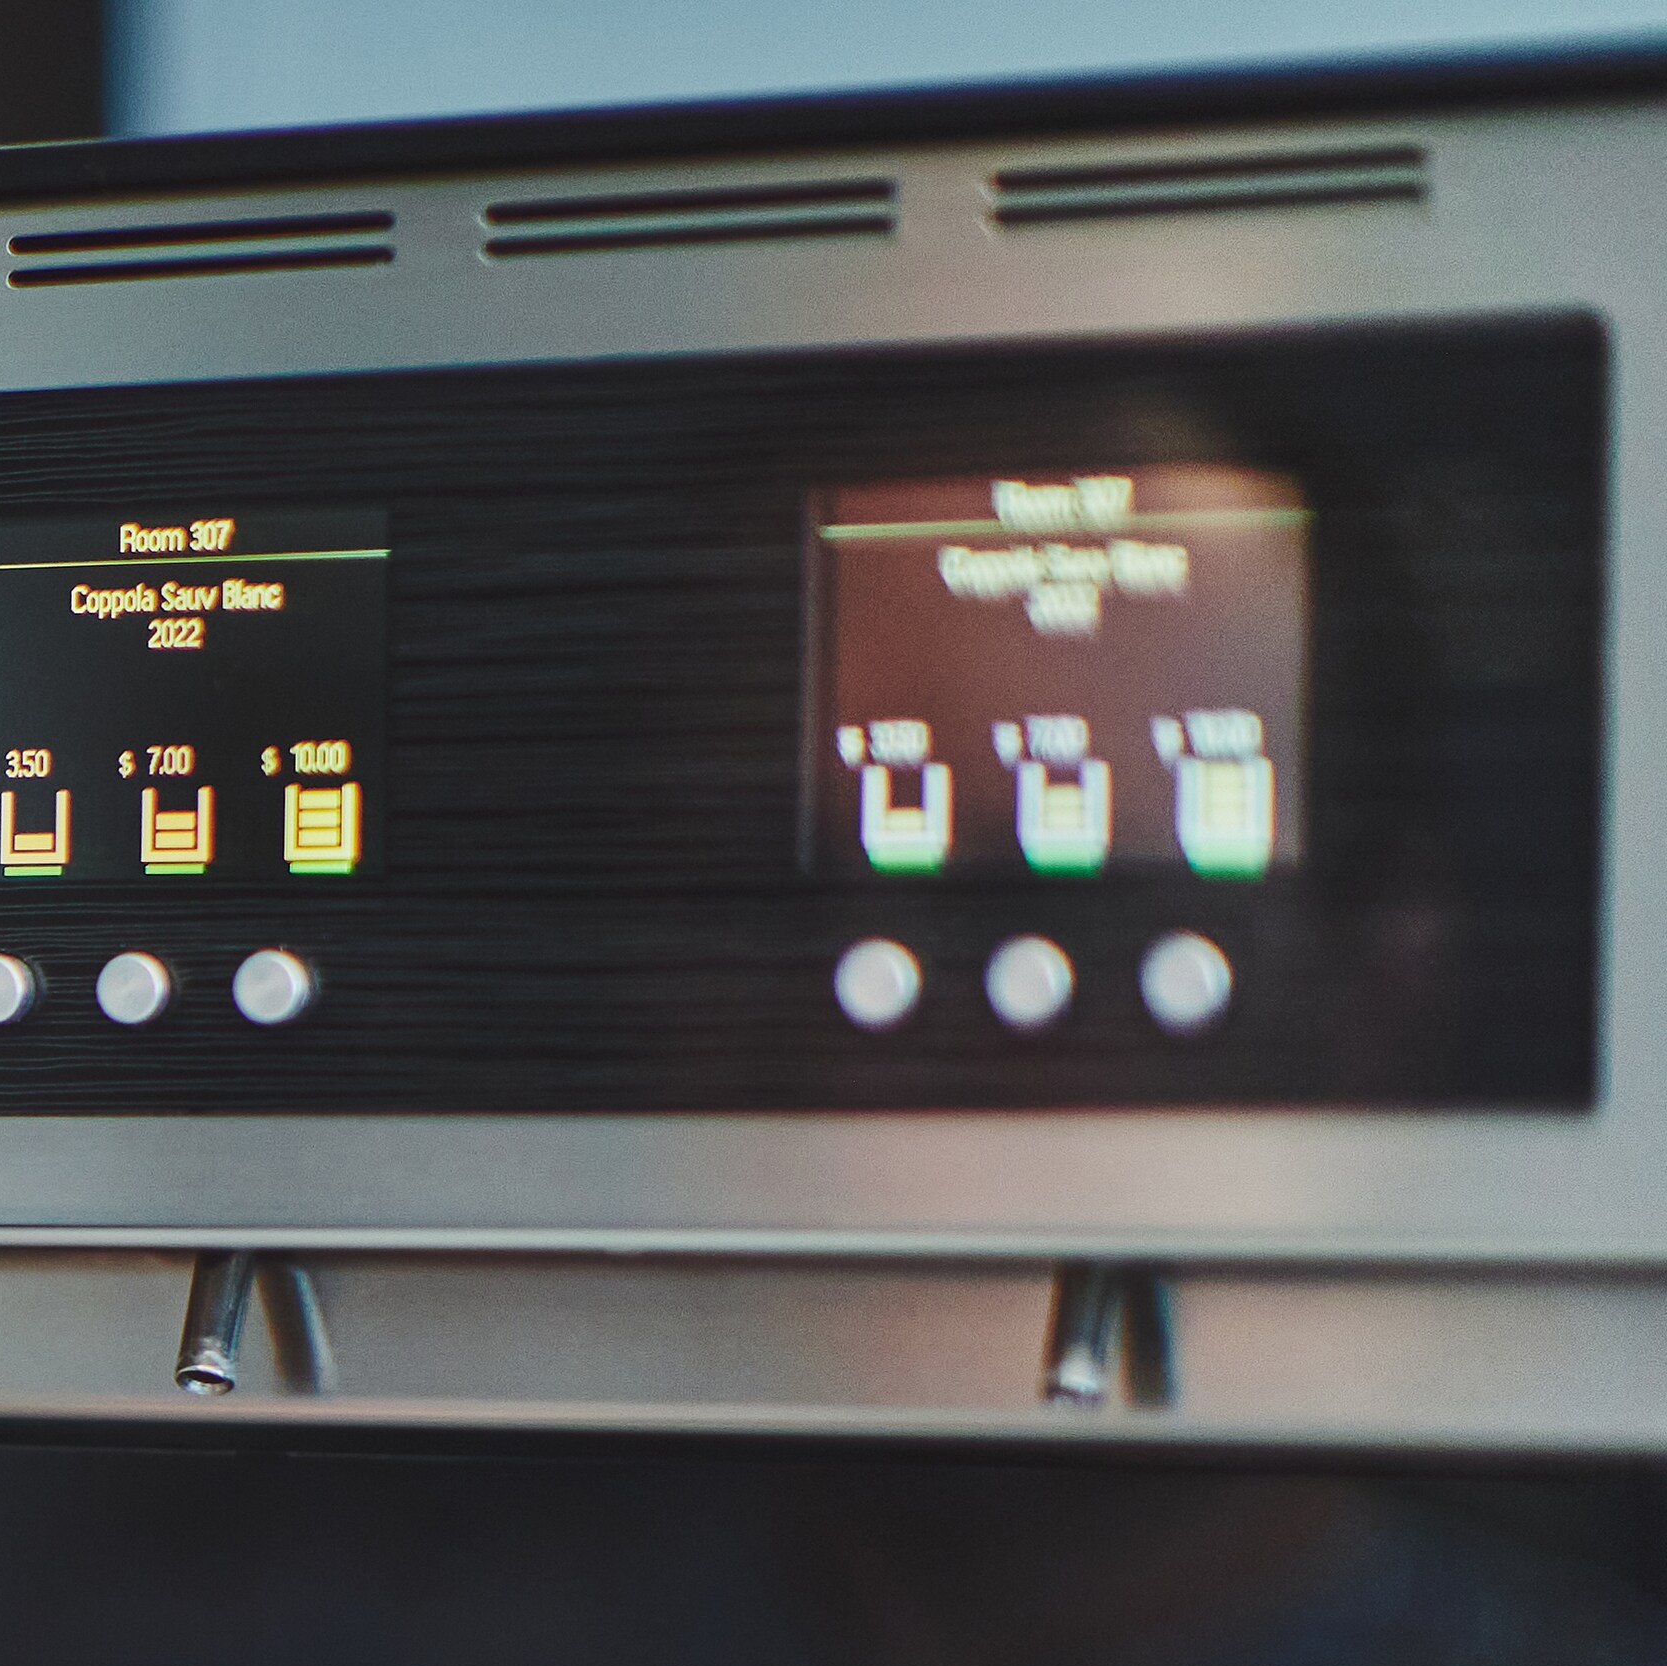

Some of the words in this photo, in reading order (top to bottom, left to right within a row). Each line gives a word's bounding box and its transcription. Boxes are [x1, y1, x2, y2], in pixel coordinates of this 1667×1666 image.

[119, 523, 185, 553] Room
[189, 518, 234, 550] 307
[71, 582, 156, 619] Coppola
[161, 581, 217, 614] Sauv
[222, 578, 284, 610] Blanc
[147, 618, 205, 649] 2022
[6, 749, 52, 778] 3.50
[118, 750, 135, 779] $
[146, 744, 195, 775] 7.00
[261, 746, 281, 776] $
[289, 740, 351, 774] 10.00
